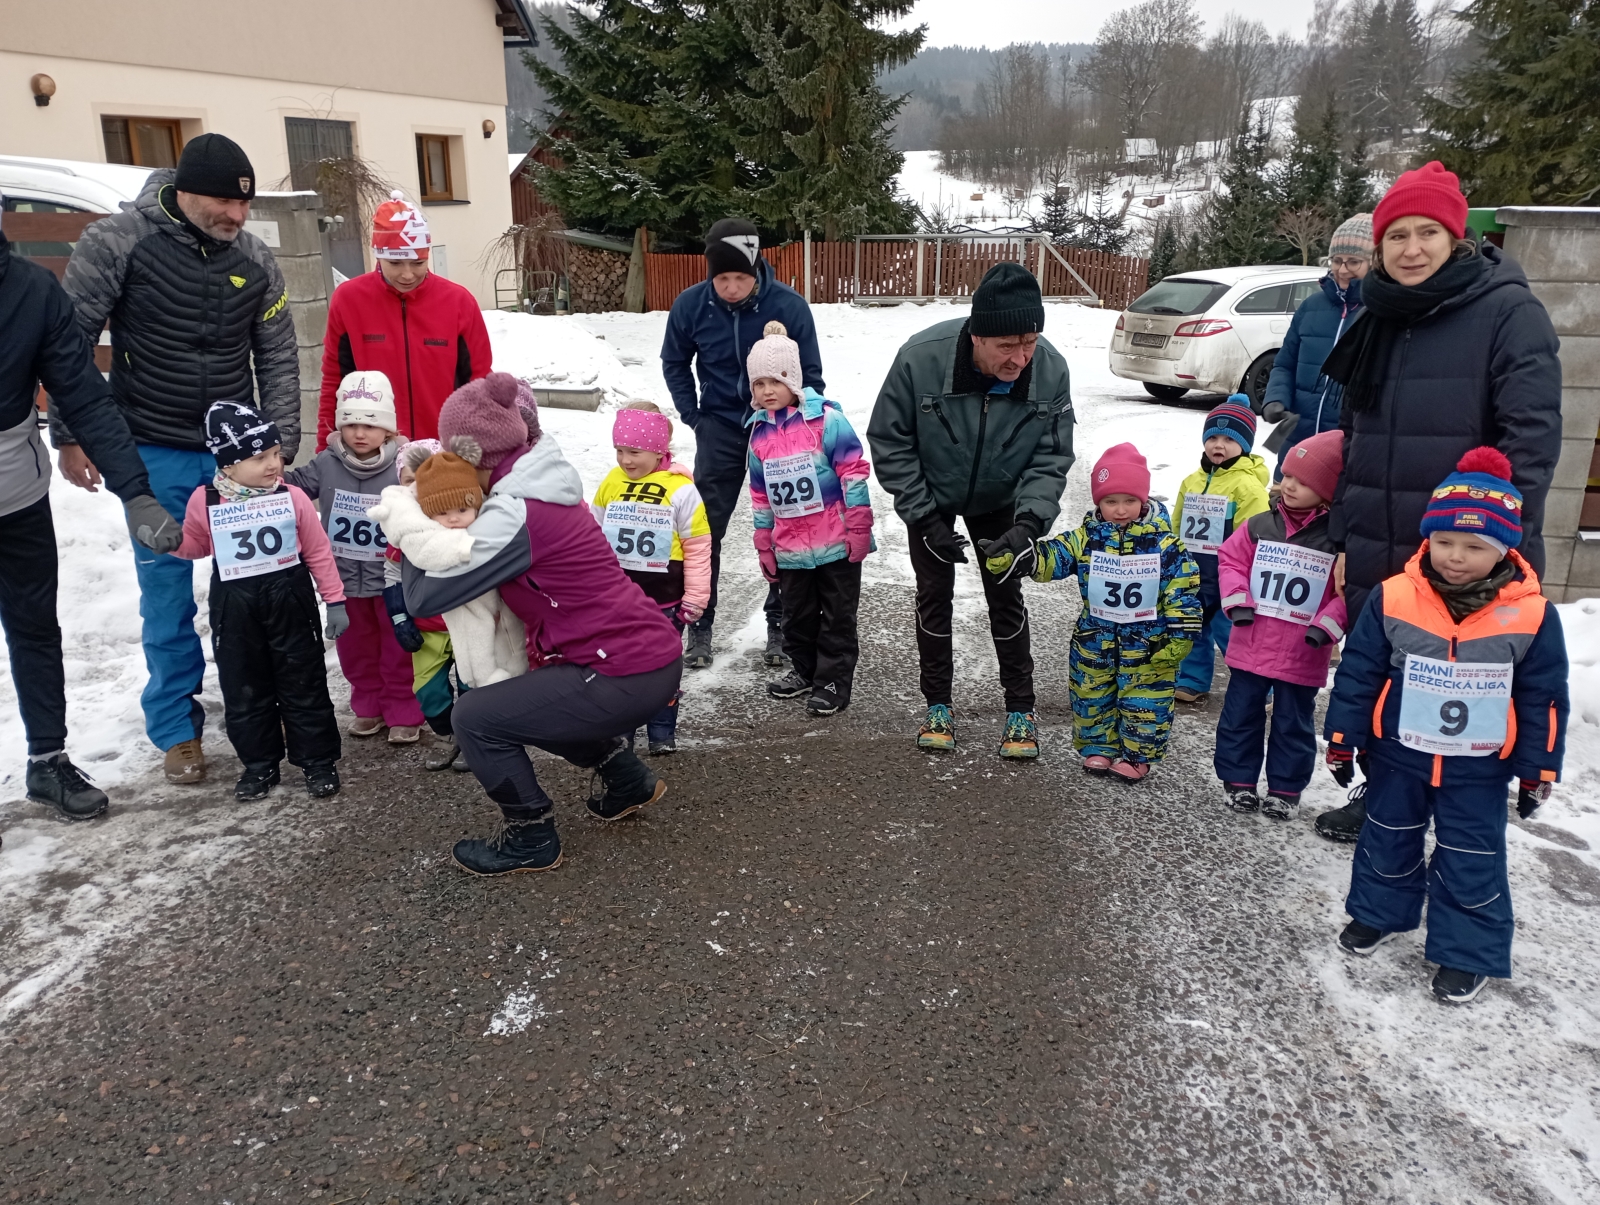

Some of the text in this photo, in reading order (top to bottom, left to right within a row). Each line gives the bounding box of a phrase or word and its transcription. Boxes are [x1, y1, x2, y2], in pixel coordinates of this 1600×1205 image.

[794, 463, 812, 472] LIGA
[336, 493, 360, 505] ZIMNÍ
[769, 477, 815, 506] 329
[212, 503, 246, 518] ZIMNÍ
[213, 507, 292, 526] BĚŽECKÁ LIGA
[609, 504, 636, 513] ZIMNÍ
[1207, 505, 1225, 513] LIGA
[650, 517, 671, 526] LIGA
[1184, 516, 1211, 541] 22
[333, 516, 389, 549] 268
[231, 526, 283, 560] 30
[615, 528, 656, 557] 56
[1258, 544, 1290, 556] ZIMNÍ
[1092, 564, 1158, 576] BĚŽECKÁ LIGA
[1093, 555, 1121, 567] ZIMNÍ
[1256, 554, 1301, 568] BĚŽECKÁ
[1303, 562, 1327, 575] LIGA
[1102, 581, 1143, 609] 36
[1260, 570, 1311, 607] 110
[1409, 660, 1454, 678] ZIMNÍ
[1408, 672, 1507, 690] BĚŽECKÁ LIGA
[1438, 700, 1469, 737] 9
